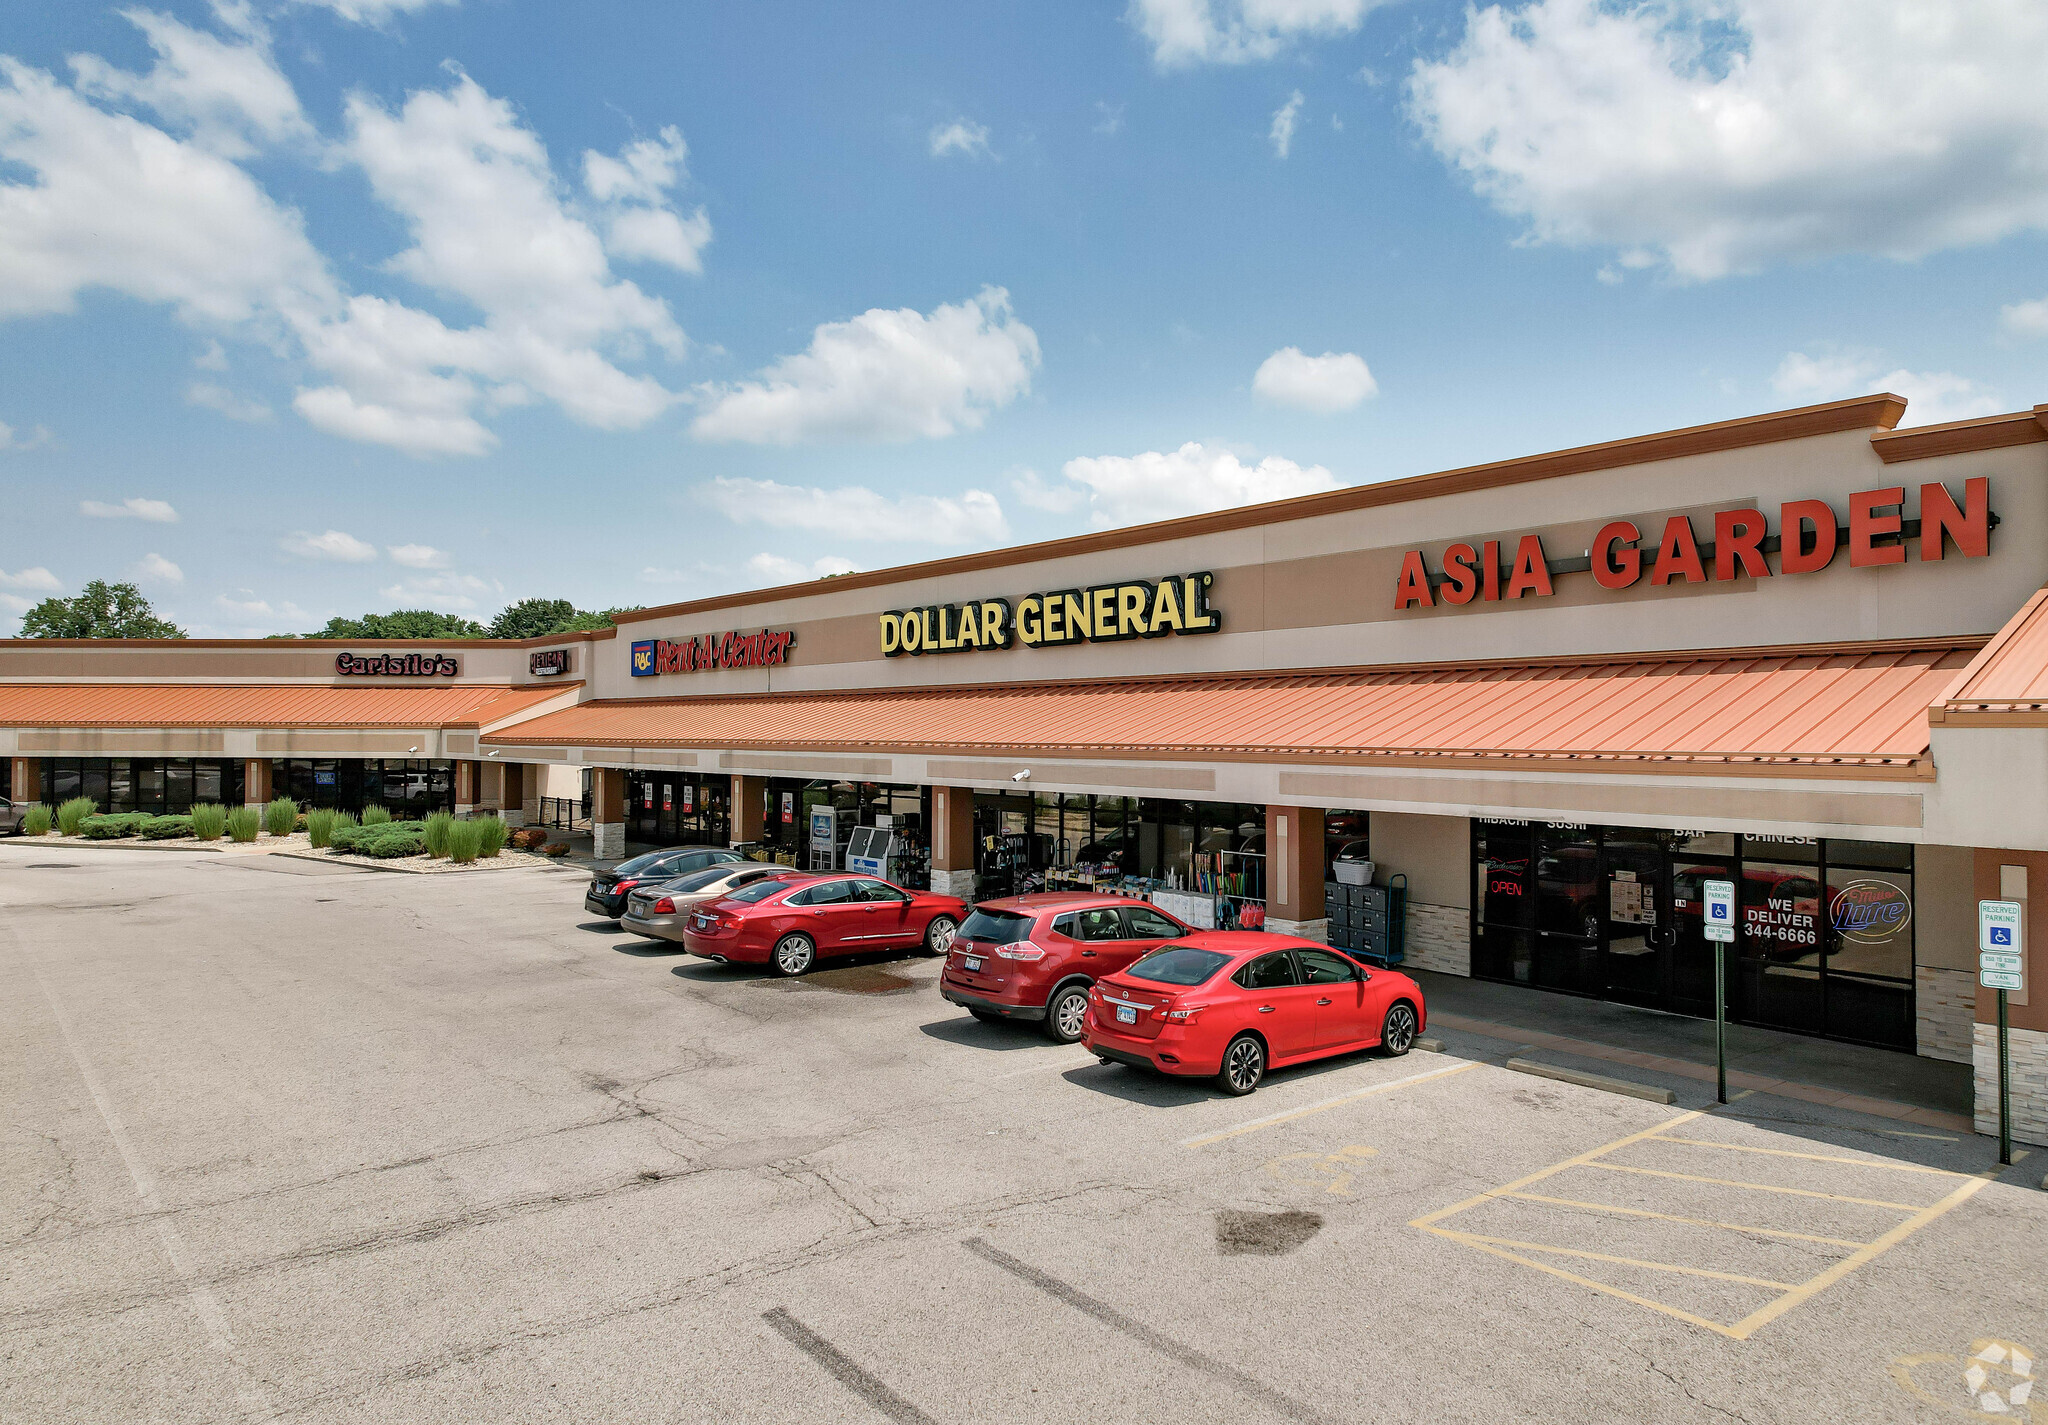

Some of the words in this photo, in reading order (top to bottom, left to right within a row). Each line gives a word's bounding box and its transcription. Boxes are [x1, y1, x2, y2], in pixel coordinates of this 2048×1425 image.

[1394, 534, 1556, 611] ASIA
[1590, 477, 1994, 590] GARDEN
[880, 602, 1005, 654] DOLLAR
[335, 652, 459, 677] Carisilo's
[529, 651, 565, 674] MEXICAN
[634, 651, 651, 672] RAC
[1674, 828, 1706, 838] BAR
[1743, 833, 1818, 845] CHINESE
[1490, 880, 1522, 896] OPEN
[1706, 884, 1732, 893] RESERVED
[1708, 892, 1730, 900] PARKING
[1768, 898, 1793, 911] WE
[1982, 905, 2018, 915] RESERVED
[1747, 909, 1813, 928] DELIVER
[1834, 902, 1905, 930] Lite
[1985, 914, 2015, 923] PARKING
[1744, 923, 1816, 944] 344-6666
